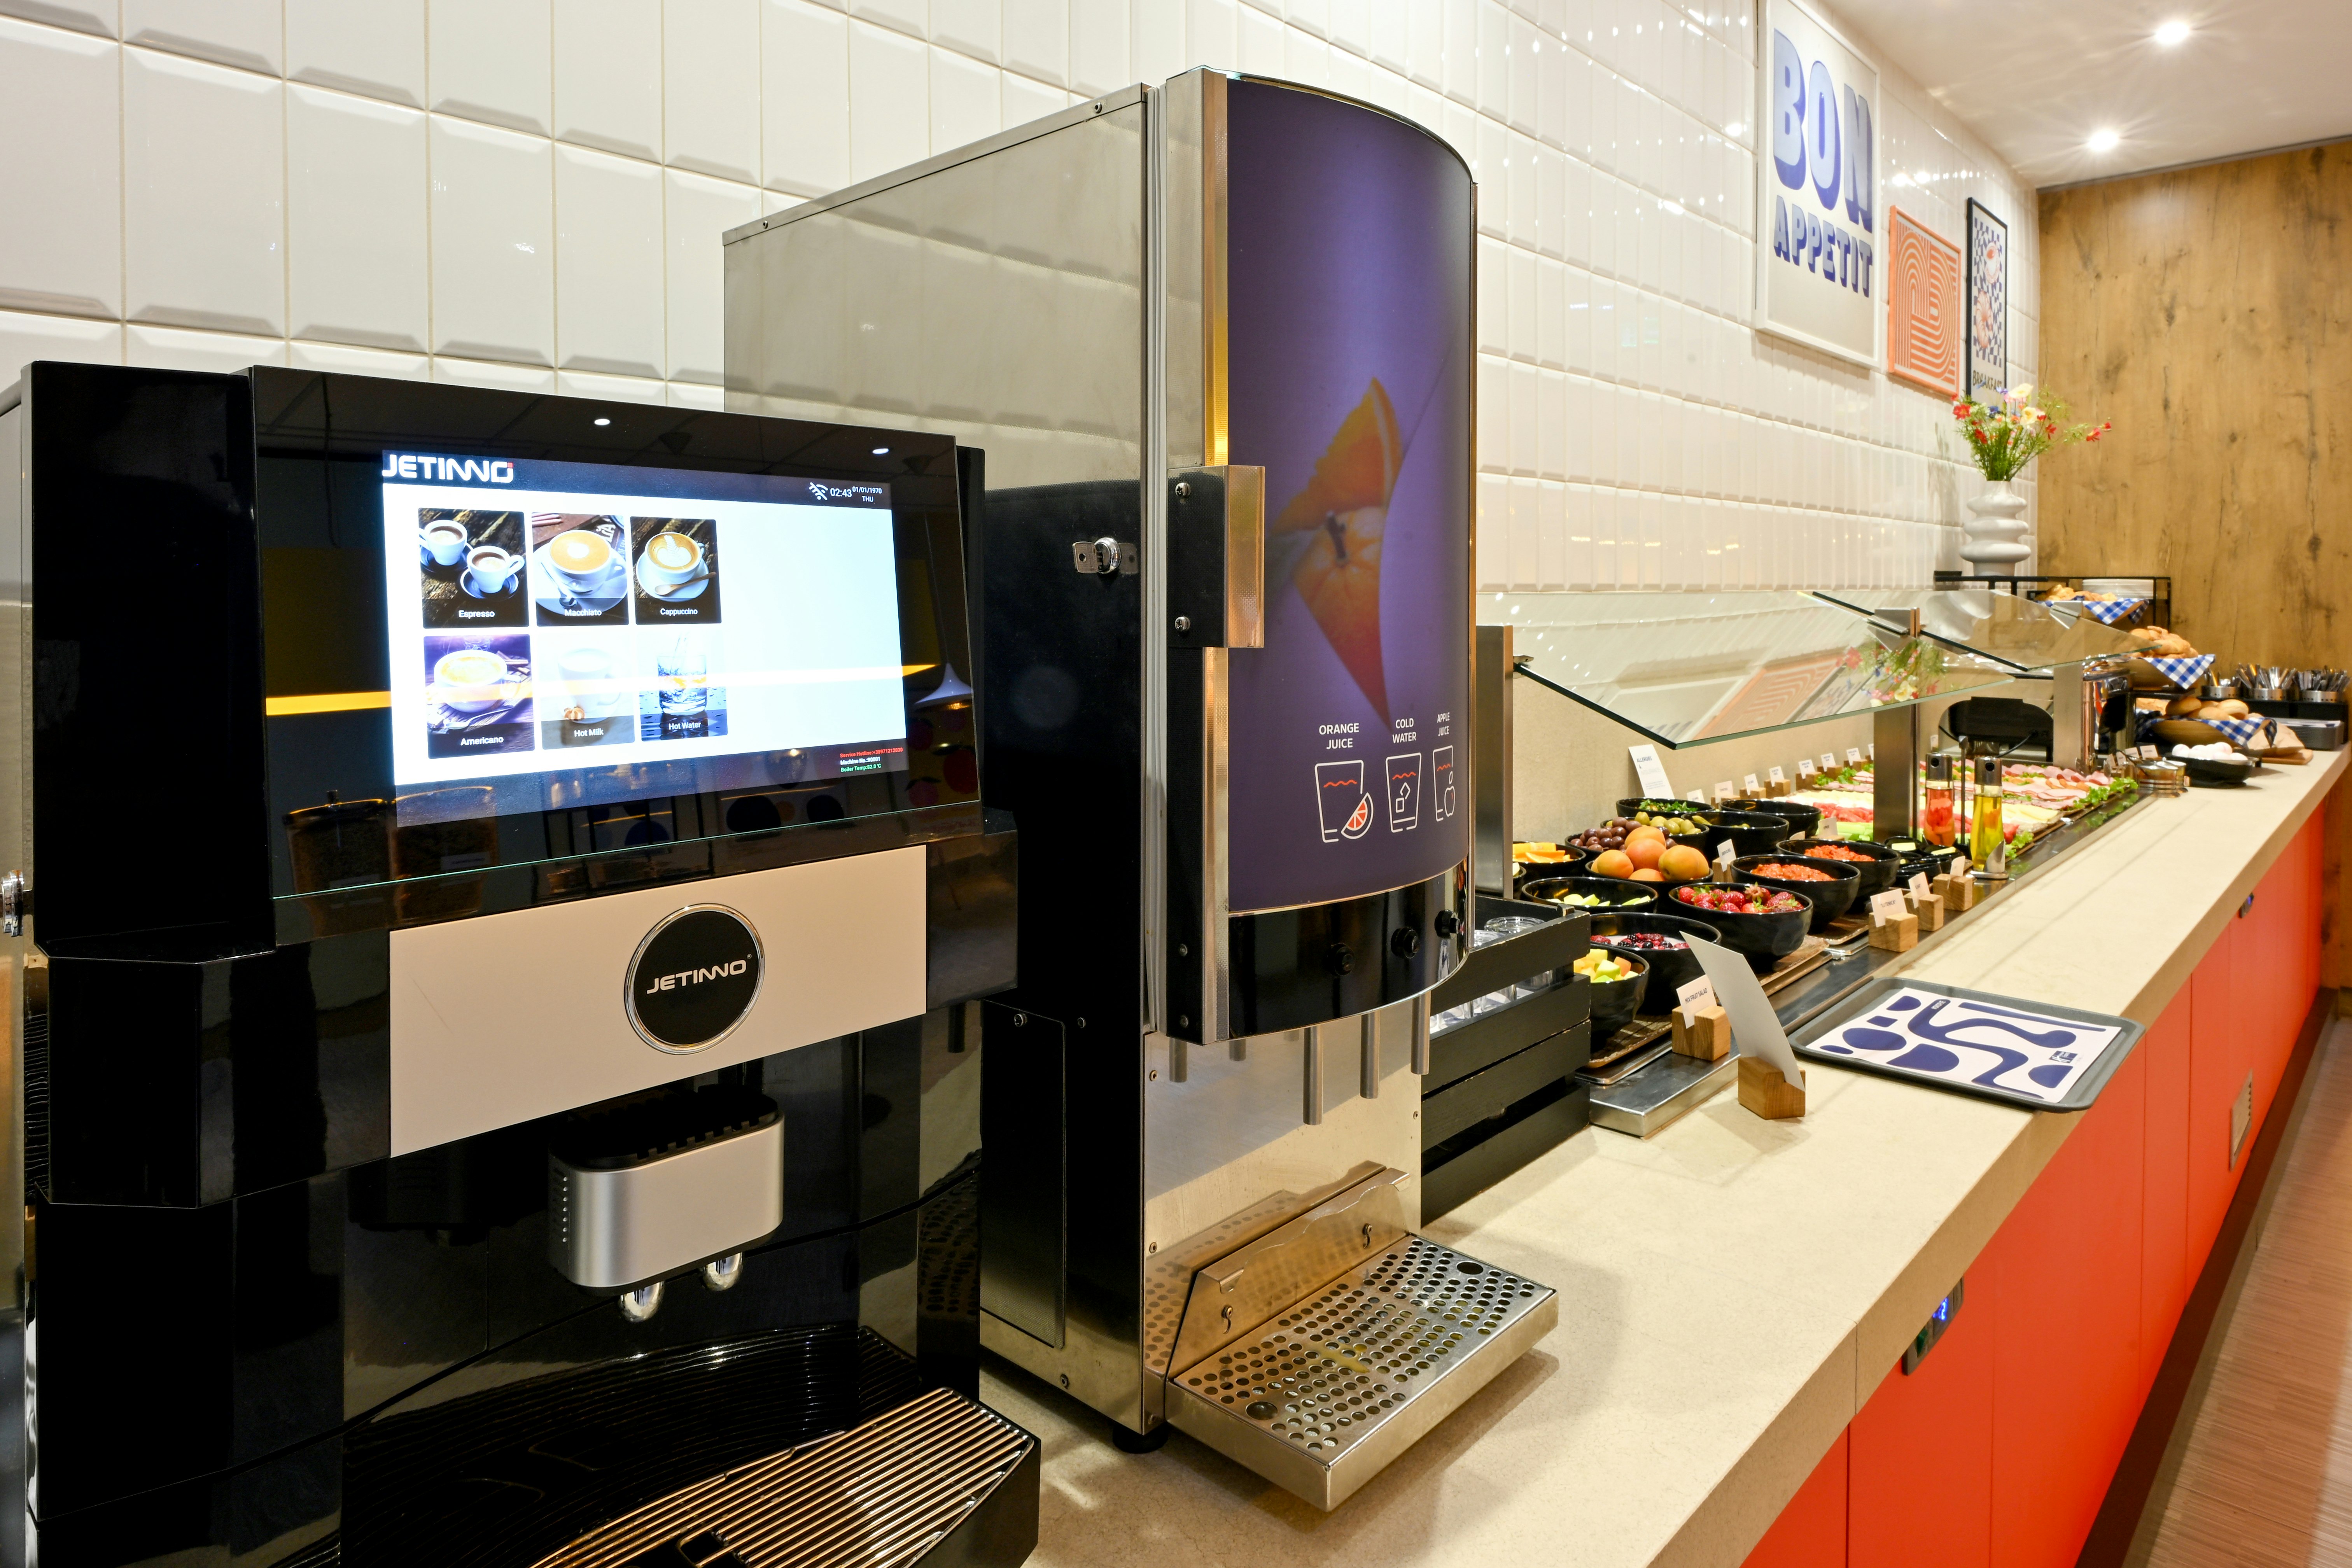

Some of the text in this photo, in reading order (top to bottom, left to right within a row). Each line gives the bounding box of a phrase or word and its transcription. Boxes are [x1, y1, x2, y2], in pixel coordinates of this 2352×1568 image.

[1773, 28, 1873, 234] BON
[1774, 195, 1873, 298] APPETIT
[382, 455, 514, 483] JETINNO
[830, 488, 852, 497] 02:43
[458, 610, 495, 619] Espresso
[660, 608, 698, 616] Cappuccino
[1437, 712, 1450, 723] APPLE
[1319, 723, 1360, 735] ORANGE
[1395, 718, 1414, 729] COLD
[589, 728, 604, 736] Milk
[1438, 726, 1449, 737] JUICE
[460, 737, 504, 746] Americano
[1392, 732, 1416, 744] WATER
[1326, 738, 1353, 750] JUICE
[647, 959, 746, 994] JETINNO
[1690, 992, 1699, 1001] FRUIT
[1698, 988, 1708, 997] SALAD
